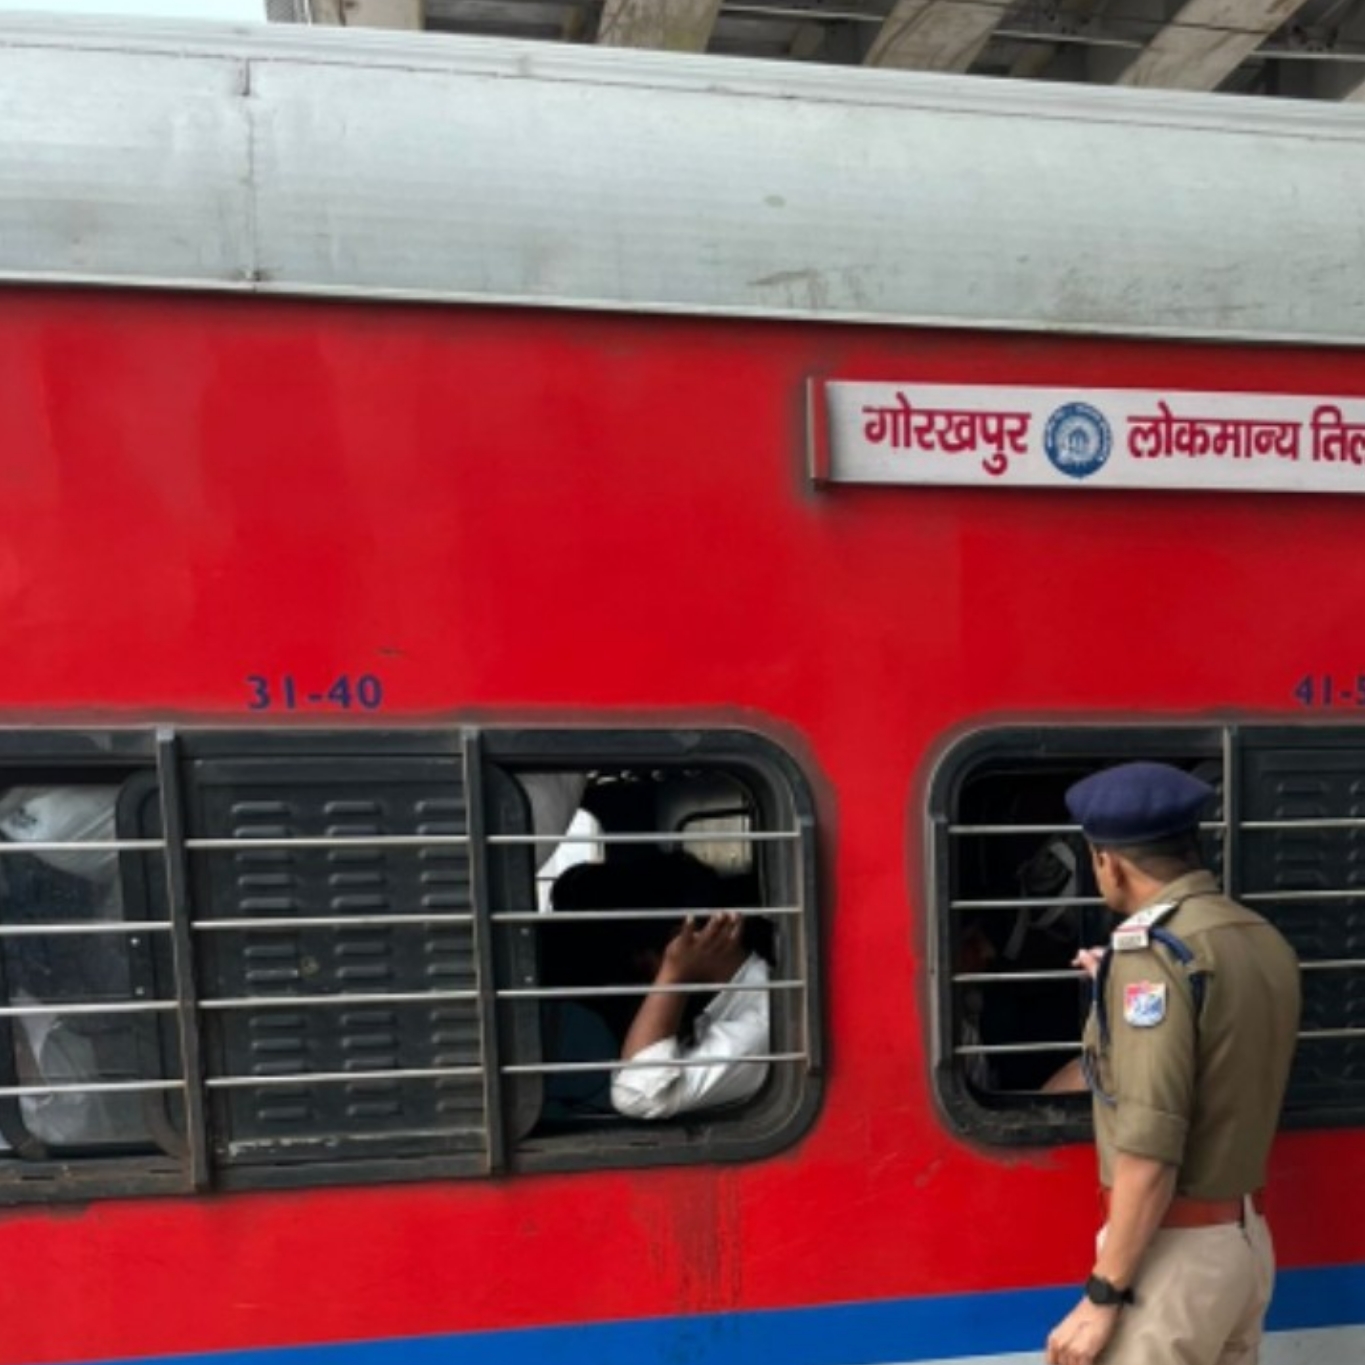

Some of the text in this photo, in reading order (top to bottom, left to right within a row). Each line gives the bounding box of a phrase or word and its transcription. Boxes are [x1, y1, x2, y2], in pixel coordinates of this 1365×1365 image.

[861, 391, 1032, 476] गोरखपुर
[1127, 400, 1303, 461] लोकमान्य
[246, 673, 383, 710] 31-40
